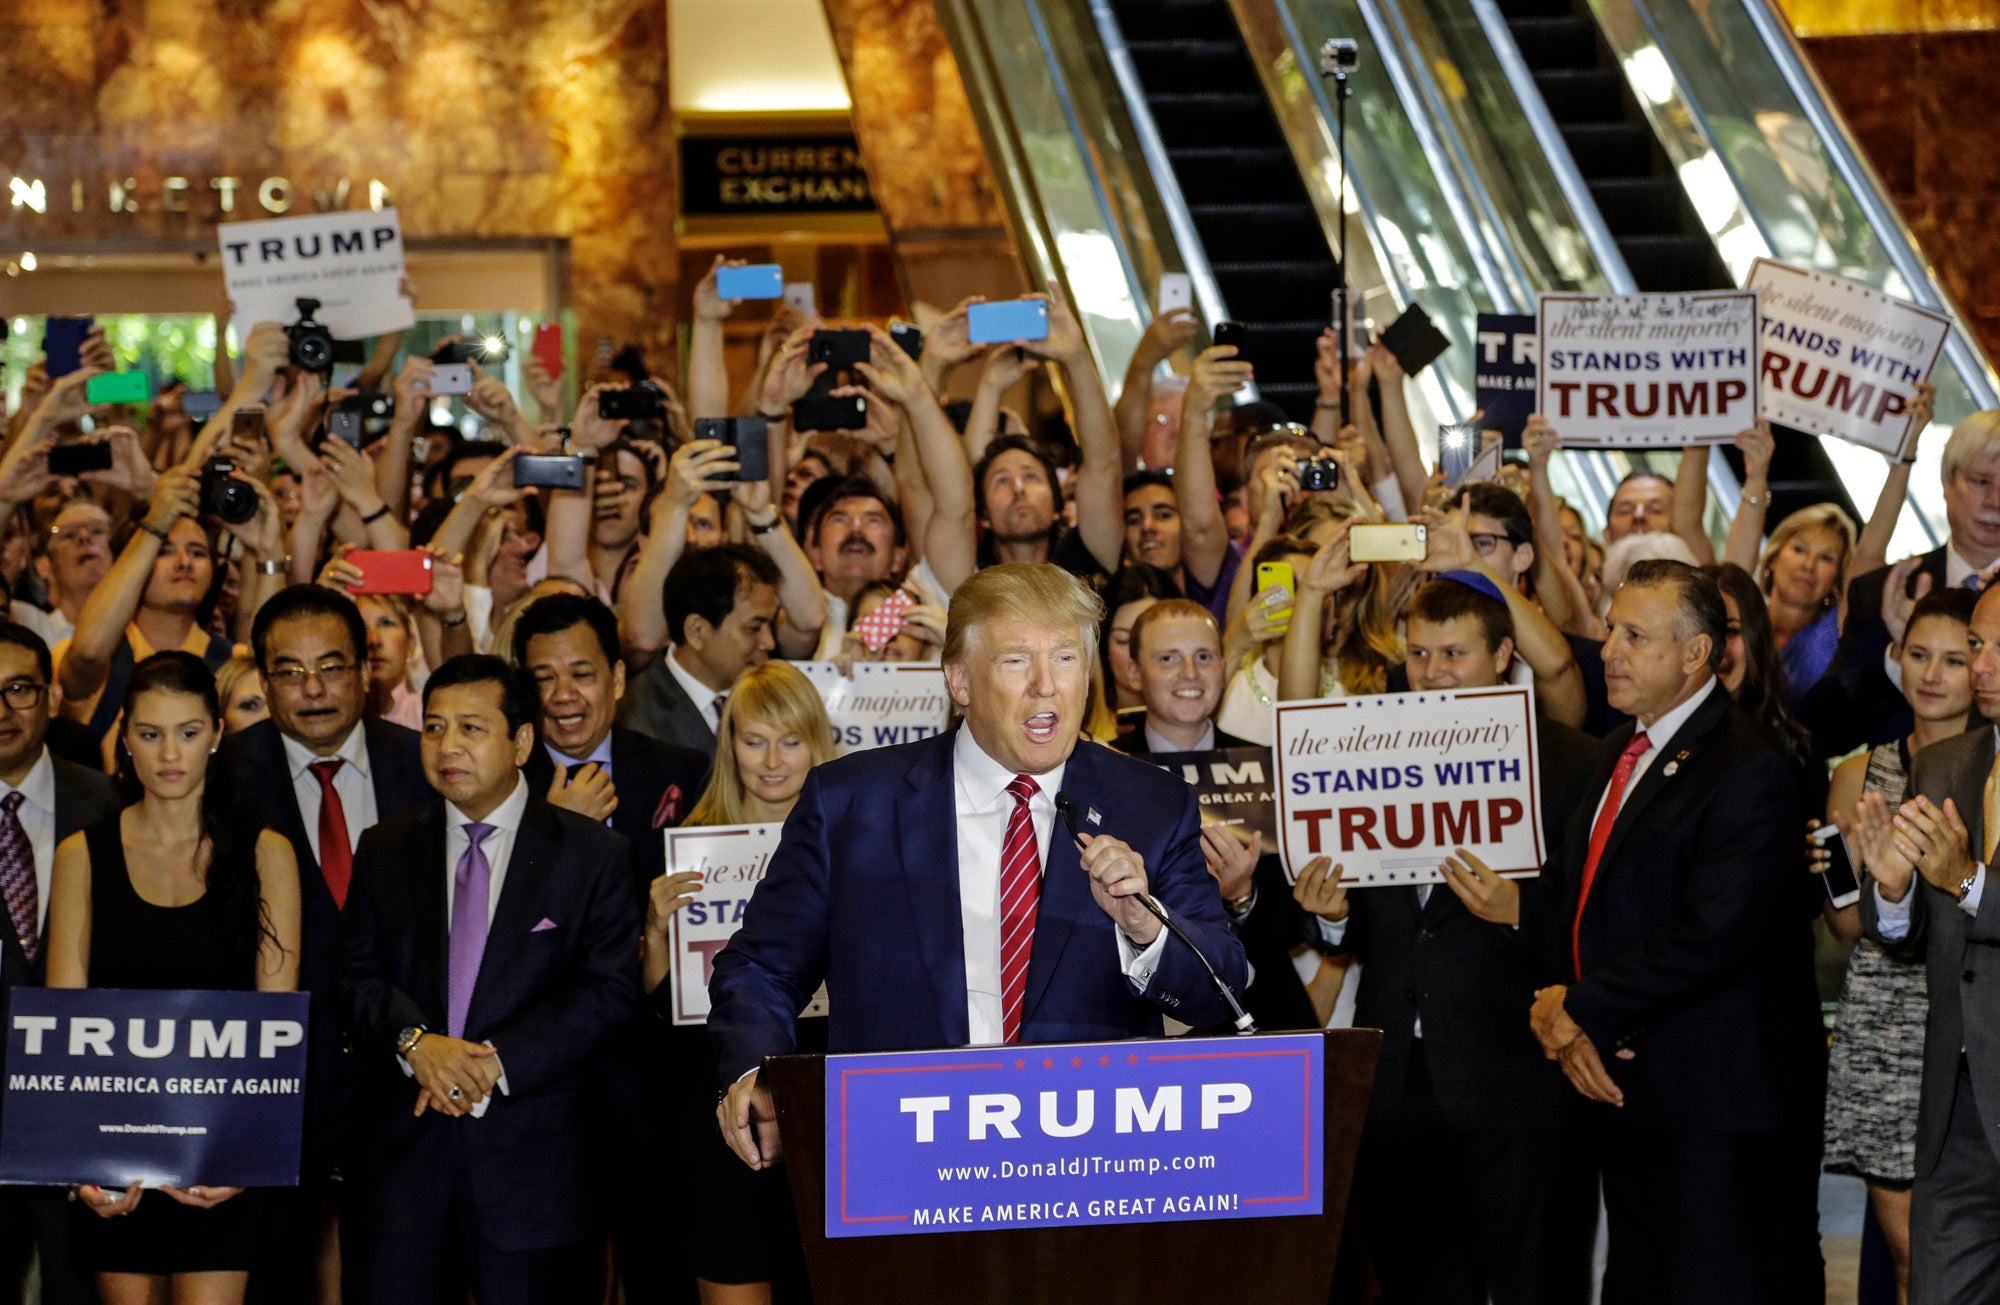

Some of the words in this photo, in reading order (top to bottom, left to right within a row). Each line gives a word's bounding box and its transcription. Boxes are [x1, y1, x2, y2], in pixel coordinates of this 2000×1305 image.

[226, 226, 395, 266] TRUMP
[1550, 316, 1583, 338] the
[1587, 318, 1644, 339] silent
[1649, 318, 1749, 346] majority
[1550, 350, 1660, 370] STANDS
[1671, 347, 1747, 369] WITH
[1851, 346, 1922, 385] WITH
[1549, 379, 1748, 419] TRUMP
[1762, 350, 1907, 426] RUMP
[1289, 728, 1329, 756] the
[1333, 724, 1403, 753] silent
[1408, 718, 1520, 755] majority
[1291, 764, 1425, 796] STANDS
[1434, 758, 1521, 786] WITH
[1199, 792, 1254, 805] GREAT
[1293, 797, 1524, 854] TRUMP
[13, 1015, 304, 1059] TRUMP
[8, 1074, 65, 1091] MAKE
[69, 1075, 160, 1094] AMERICA
[165, 1078, 228, 1095] GREAT
[231, 1078, 300, 1095] AGAIN!
[900, 1082, 1252, 1143] TRUMP
[938, 1154, 1216, 1182] www.DonaldJTrump.com
[912, 1206, 973, 1226] MAKE
[981, 1201, 1080, 1222] AMERICA
[1088, 1198, 1156, 1218] GREAT
[1163, 1194, 1239, 1214] AGAIN!
